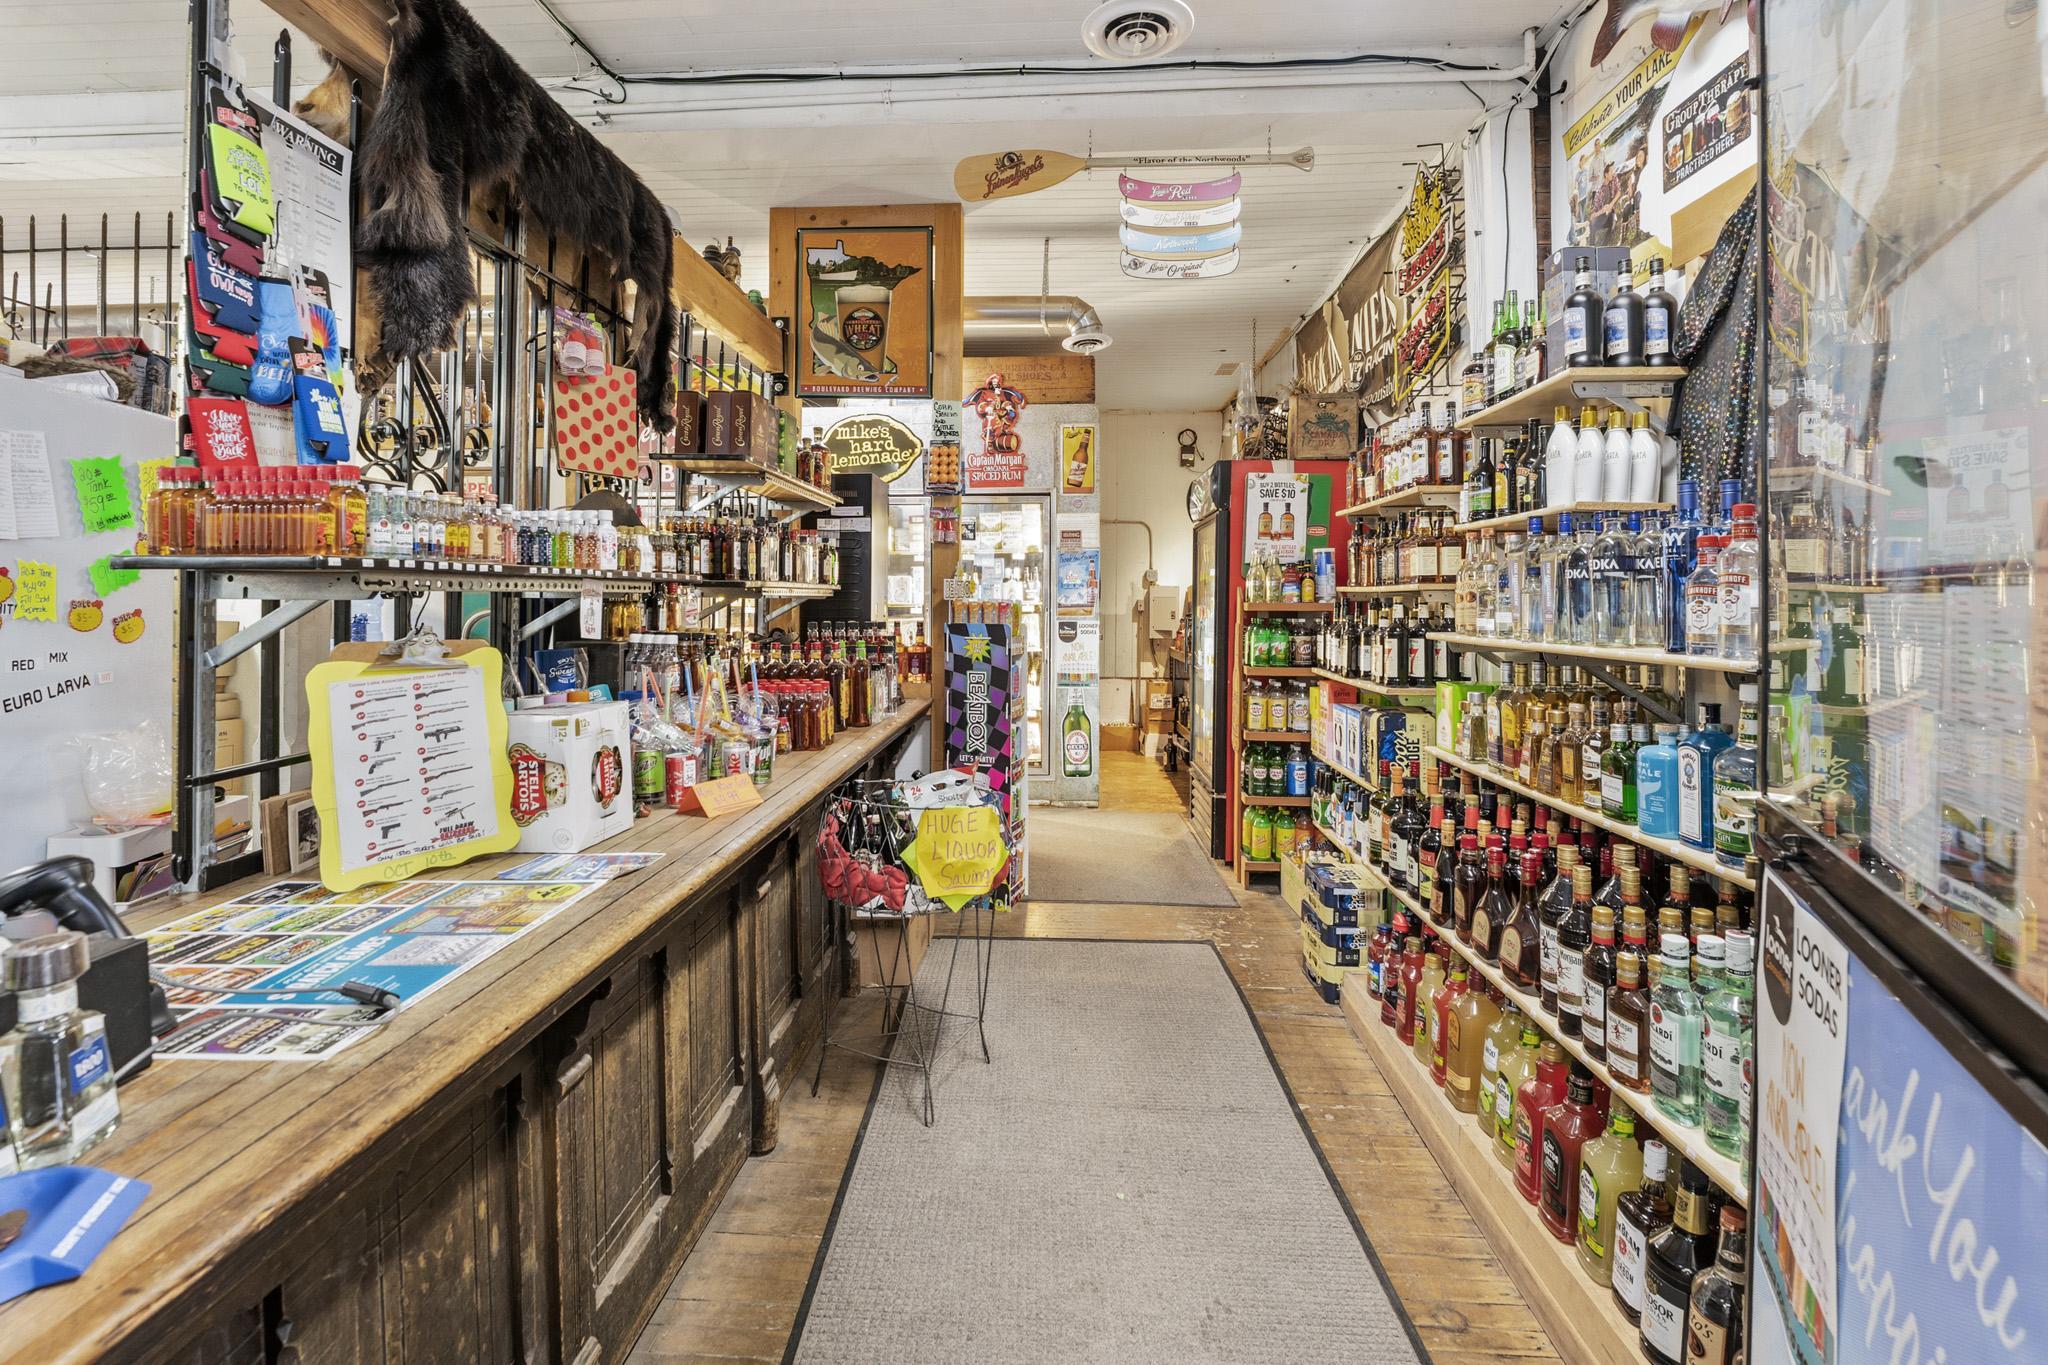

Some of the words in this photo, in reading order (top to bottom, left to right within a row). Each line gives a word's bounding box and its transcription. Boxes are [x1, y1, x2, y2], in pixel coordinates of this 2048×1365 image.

[1615, 72, 1643, 104] YOUR
[1645, 52, 1673, 82] LAKE
[1665, 102, 1700, 136] GROUP
[274, 118, 337, 167] WARNING
[1676, 149, 1715, 180] PRACTICED
[1715, 134, 1736, 155] HERE
[1161, 155, 1175, 165] of
[1178, 155, 1192, 163] the
[845, 324, 883, 338] WHEAT
[835, 424, 891, 440] mike's
[849, 437, 896, 455] hard
[830, 450, 911, 469] lemonade
[968, 454, 995, 467] Captain
[994, 454, 1023, 466] Morgan
[971, 471, 1001, 481] SPICED
[1001, 471, 1022, 481] RUM
[1259, 488, 1280, 499] SAVE
[1281, 488, 1297, 500] $10
[11, 658, 36, 672] RED
[49, 651, 69, 664] MIX
[2, 689, 43, 714] EURO
[46, 674, 92, 700] LARVA
[967, 672, 988, 752] BEATBOX
[517, 760, 530, 811] ARTOIS
[528, 760, 541, 812] STELLA
[910, 786, 921, 796] 24
[925, 810, 979, 835] HUGE
[1717, 830, 1732, 844] GIN
[931, 839, 997, 862] LIQUOR
[1795, 925, 1844, 1001] LOONER
[1797, 971, 1839, 1040] SODAS
[1781, 1030, 1806, 1114] NOW
[1922, 1091, 2028, 1352] You
[1621, 1222, 1642, 1259] BEAM
